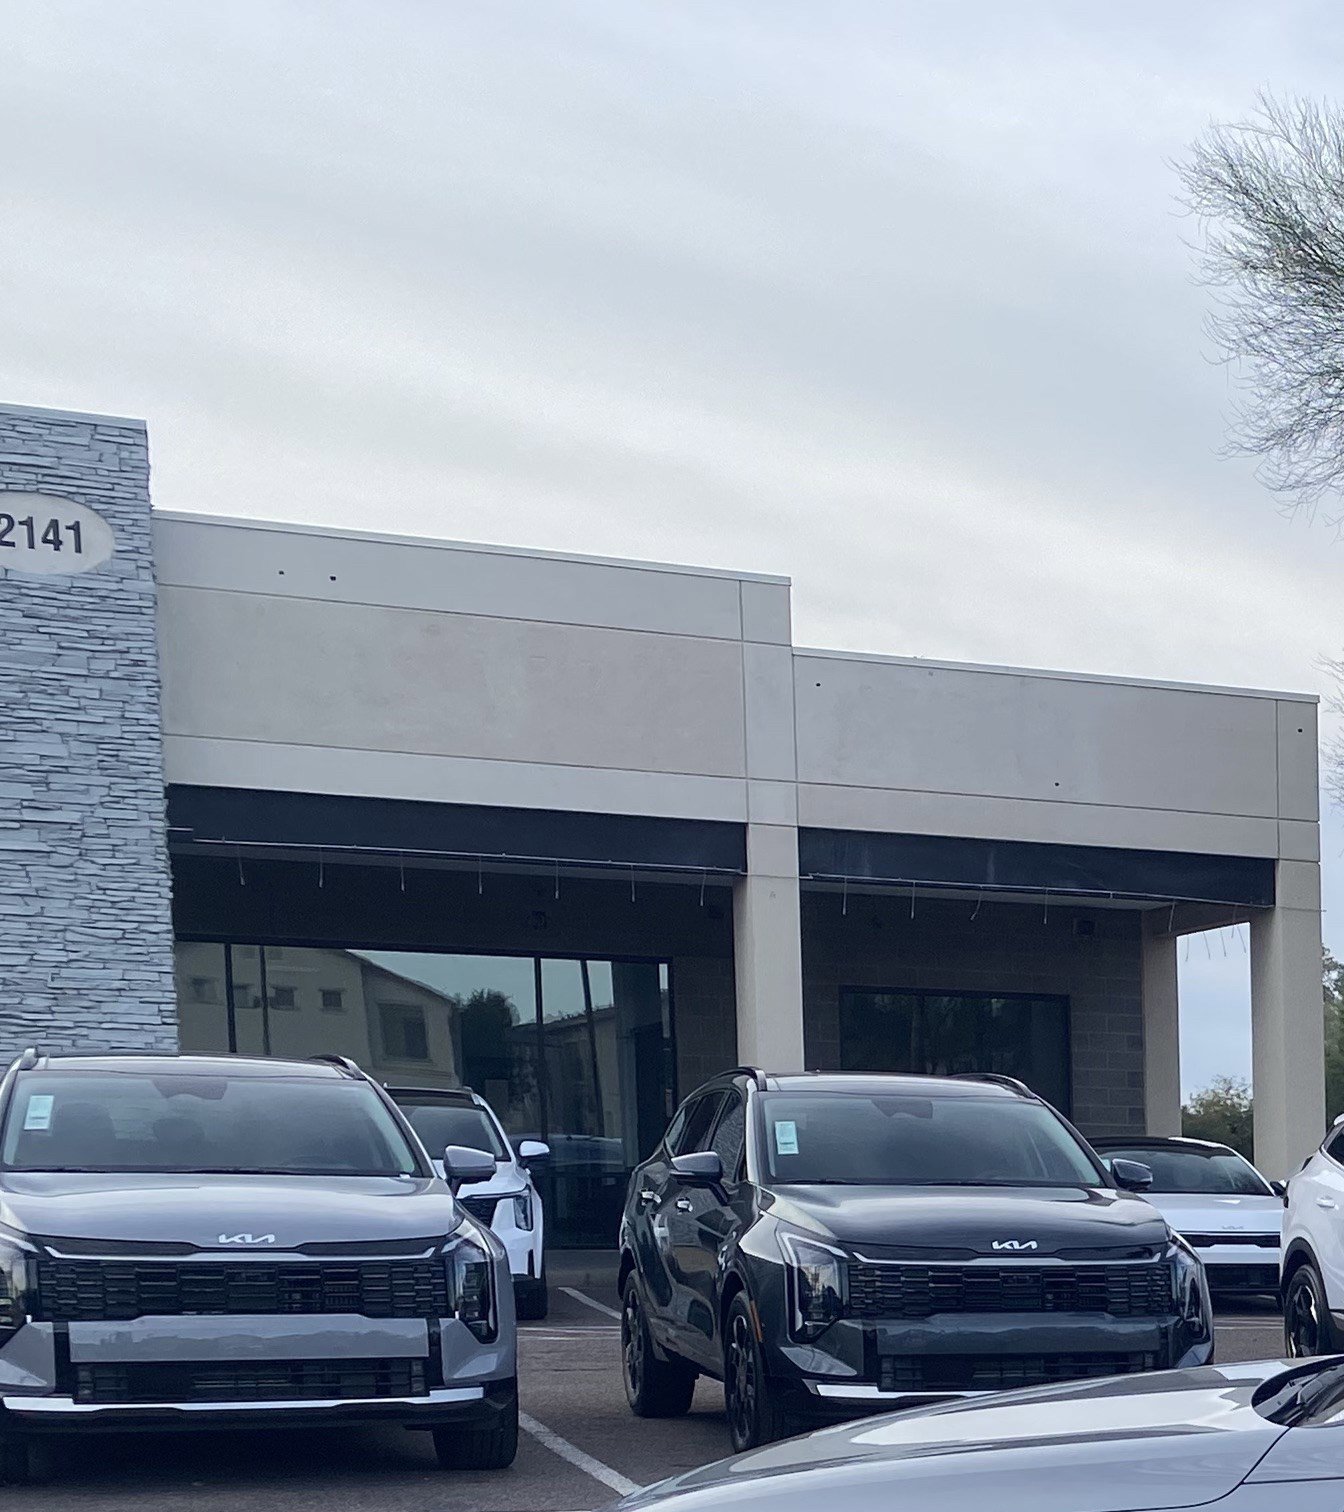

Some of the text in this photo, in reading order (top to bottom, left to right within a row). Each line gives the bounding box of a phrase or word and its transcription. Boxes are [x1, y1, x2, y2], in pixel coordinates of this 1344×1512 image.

[0, 513, 82, 554] 2141
[218, 1233, 276, 1244] KIA
[991, 1240, 1038, 1250] KIA
